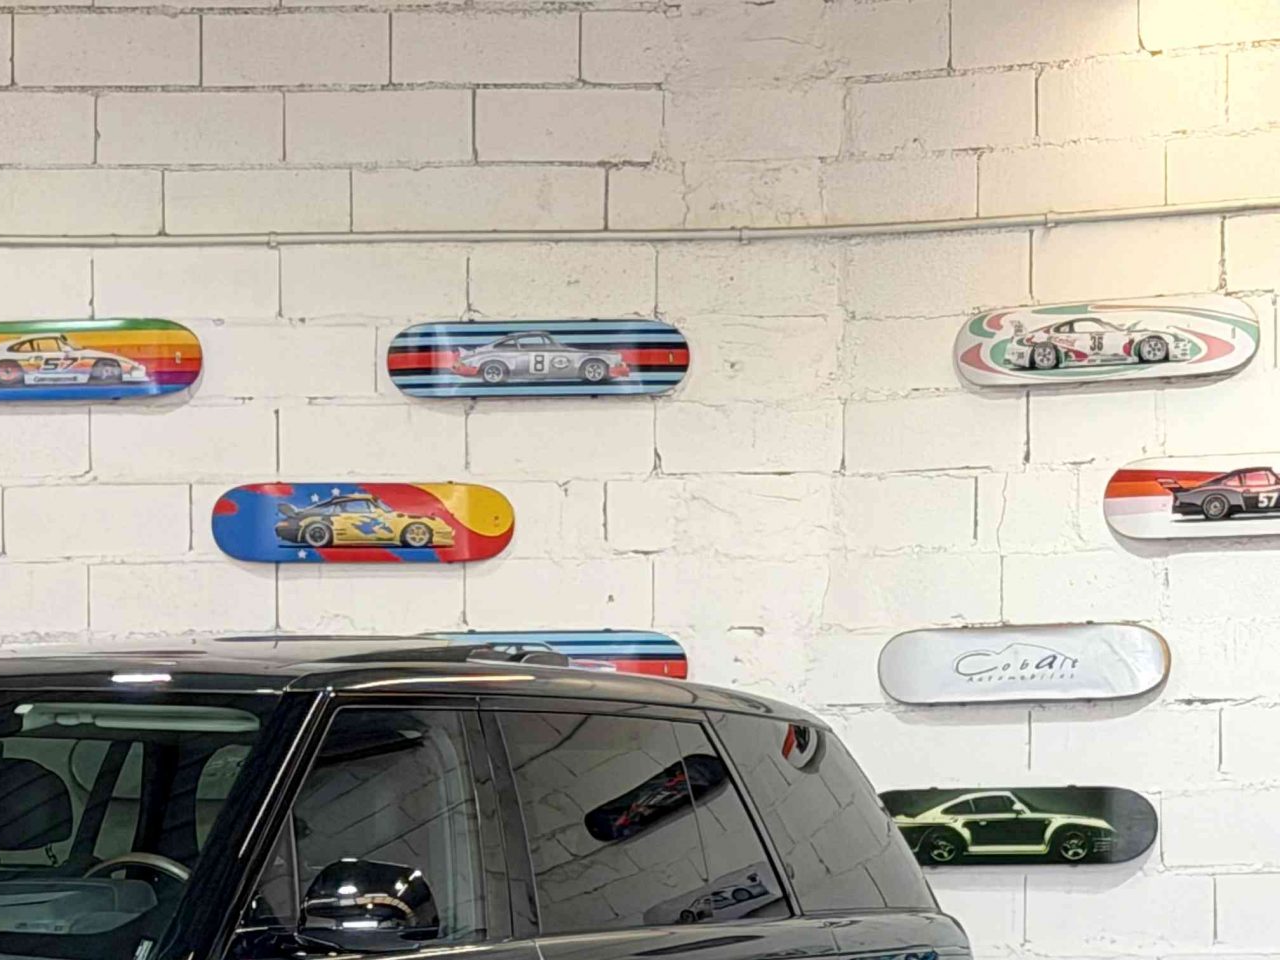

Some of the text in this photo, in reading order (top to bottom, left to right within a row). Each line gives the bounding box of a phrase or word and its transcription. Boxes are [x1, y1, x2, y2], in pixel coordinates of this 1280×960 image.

[1089, 334, 1103, 352] 36
[43, 357, 78, 371] 57
[534, 354, 545, 372] 8
[1257, 492, 1277, 508] 57
